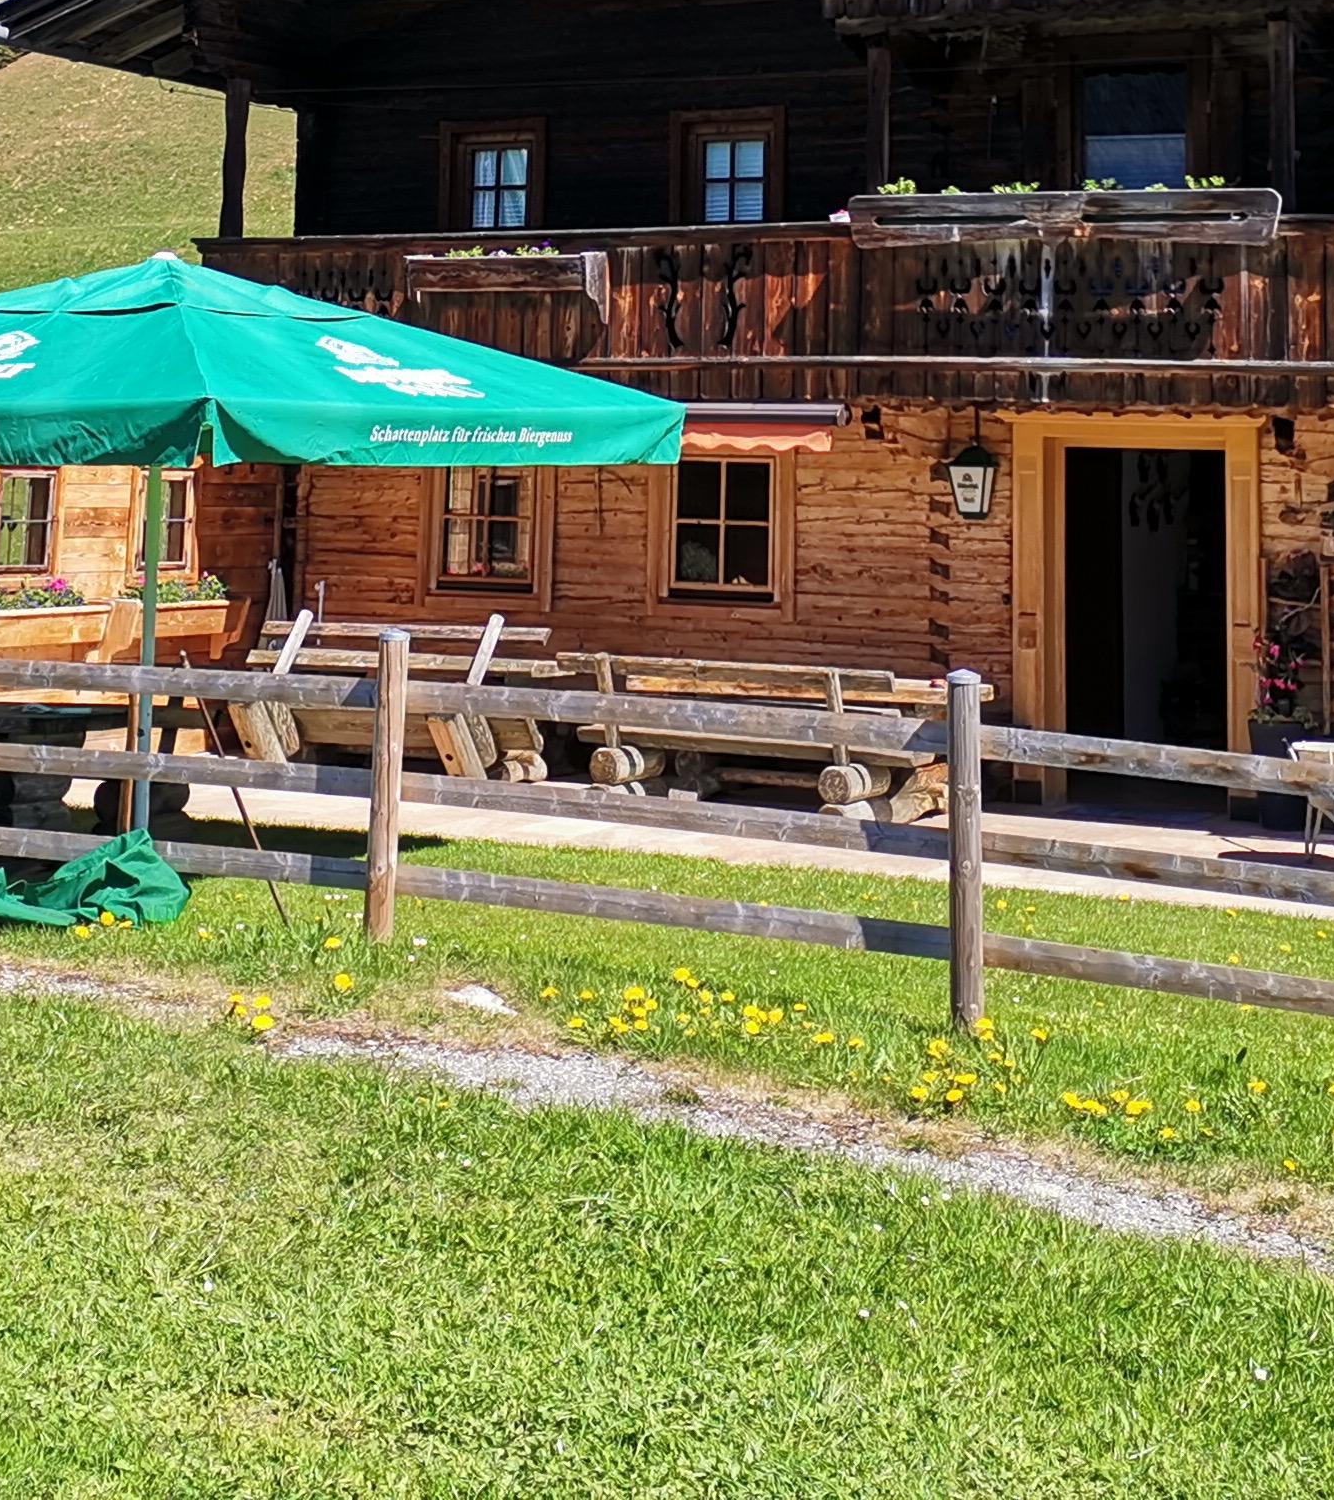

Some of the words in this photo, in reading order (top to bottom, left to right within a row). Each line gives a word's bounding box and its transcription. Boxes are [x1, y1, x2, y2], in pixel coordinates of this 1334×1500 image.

[369, 424, 451, 447] Schattenplatz
[450, 425, 472, 443] für
[470, 426, 516, 443] frischen
[517, 427, 573, 448] Biergenuss
